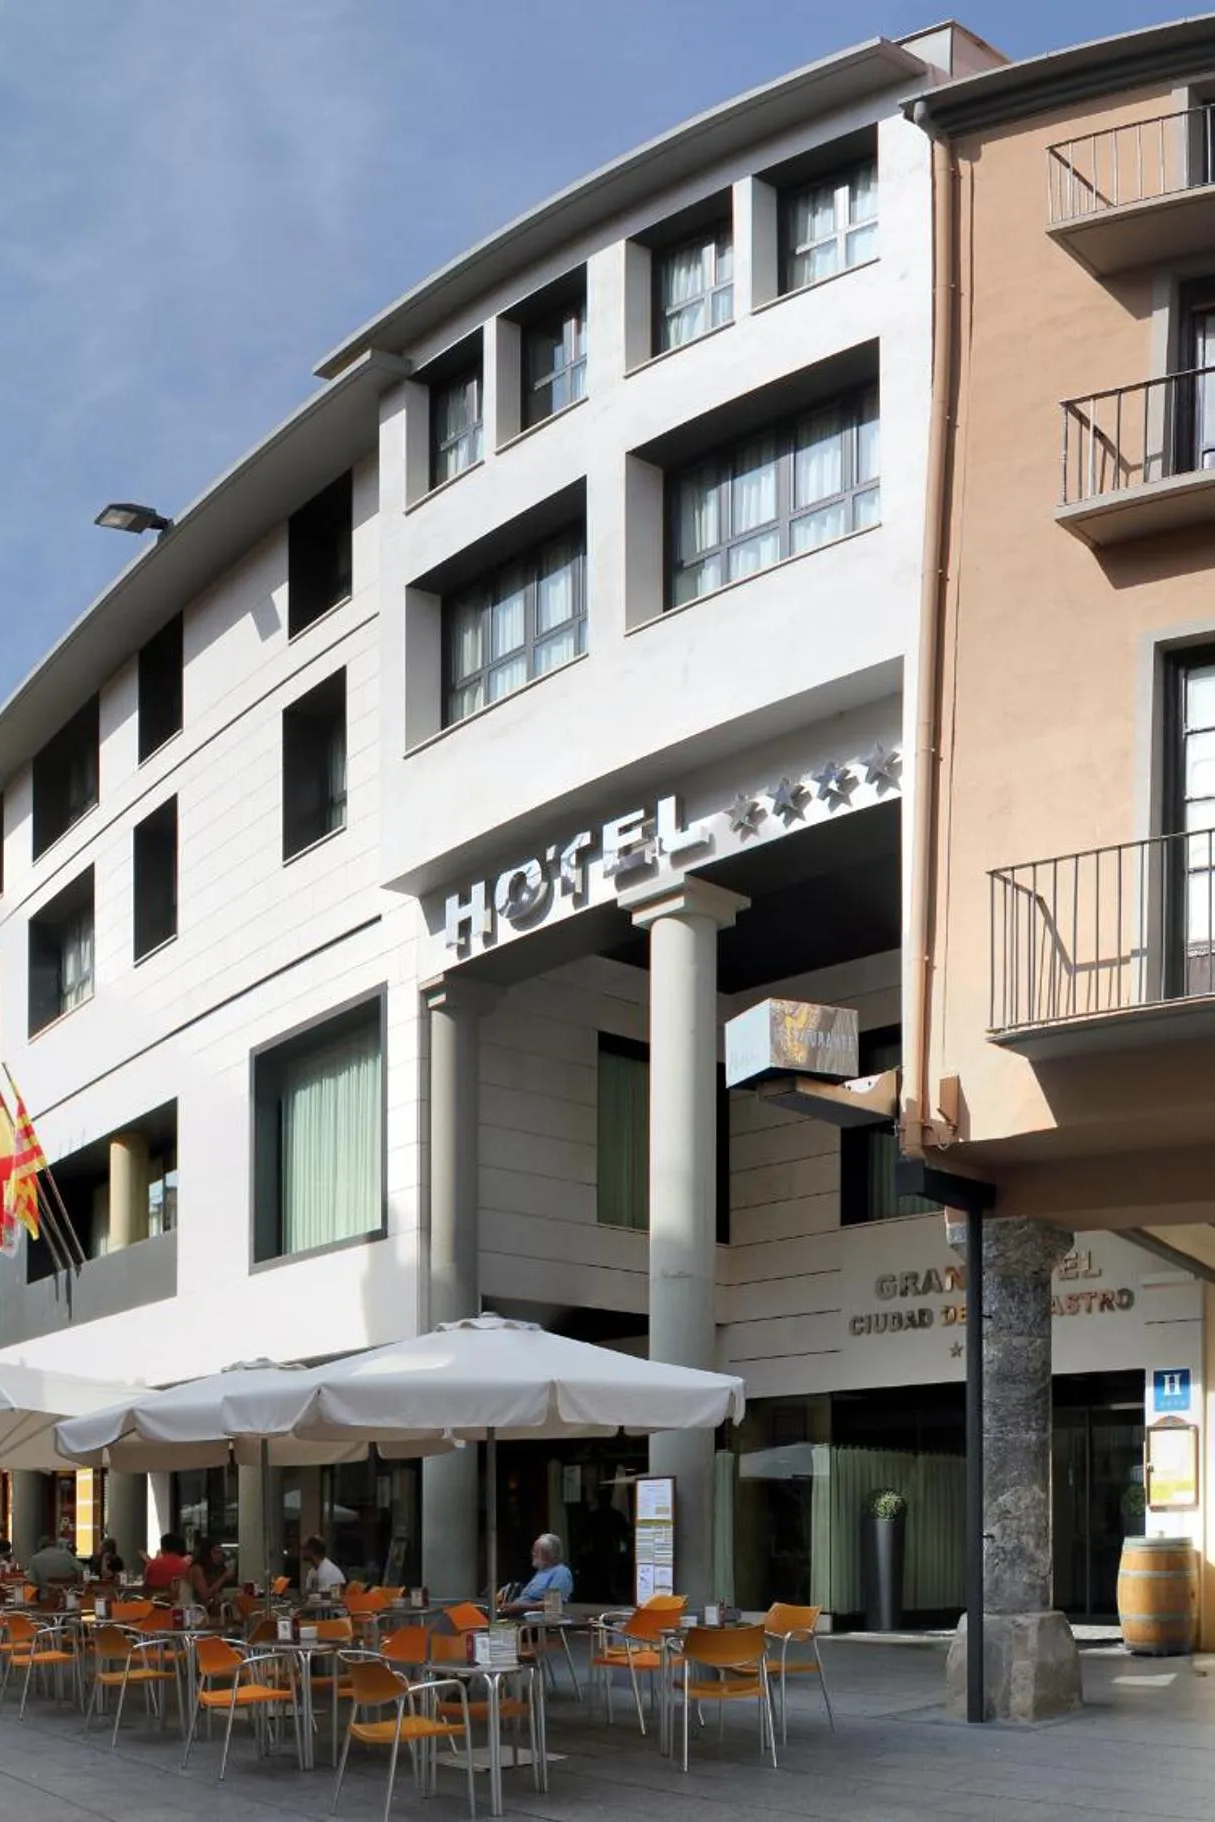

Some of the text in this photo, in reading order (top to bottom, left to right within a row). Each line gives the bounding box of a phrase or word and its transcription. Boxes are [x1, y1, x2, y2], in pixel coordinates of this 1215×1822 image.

[445, 795, 712, 949] HOTEL
[875, 1265, 967, 1299] GRAN
[849, 1307, 934, 1336] CIUDAD
[940, 1304, 967, 1327] DE
[1163, 1373, 1182, 1396] H
